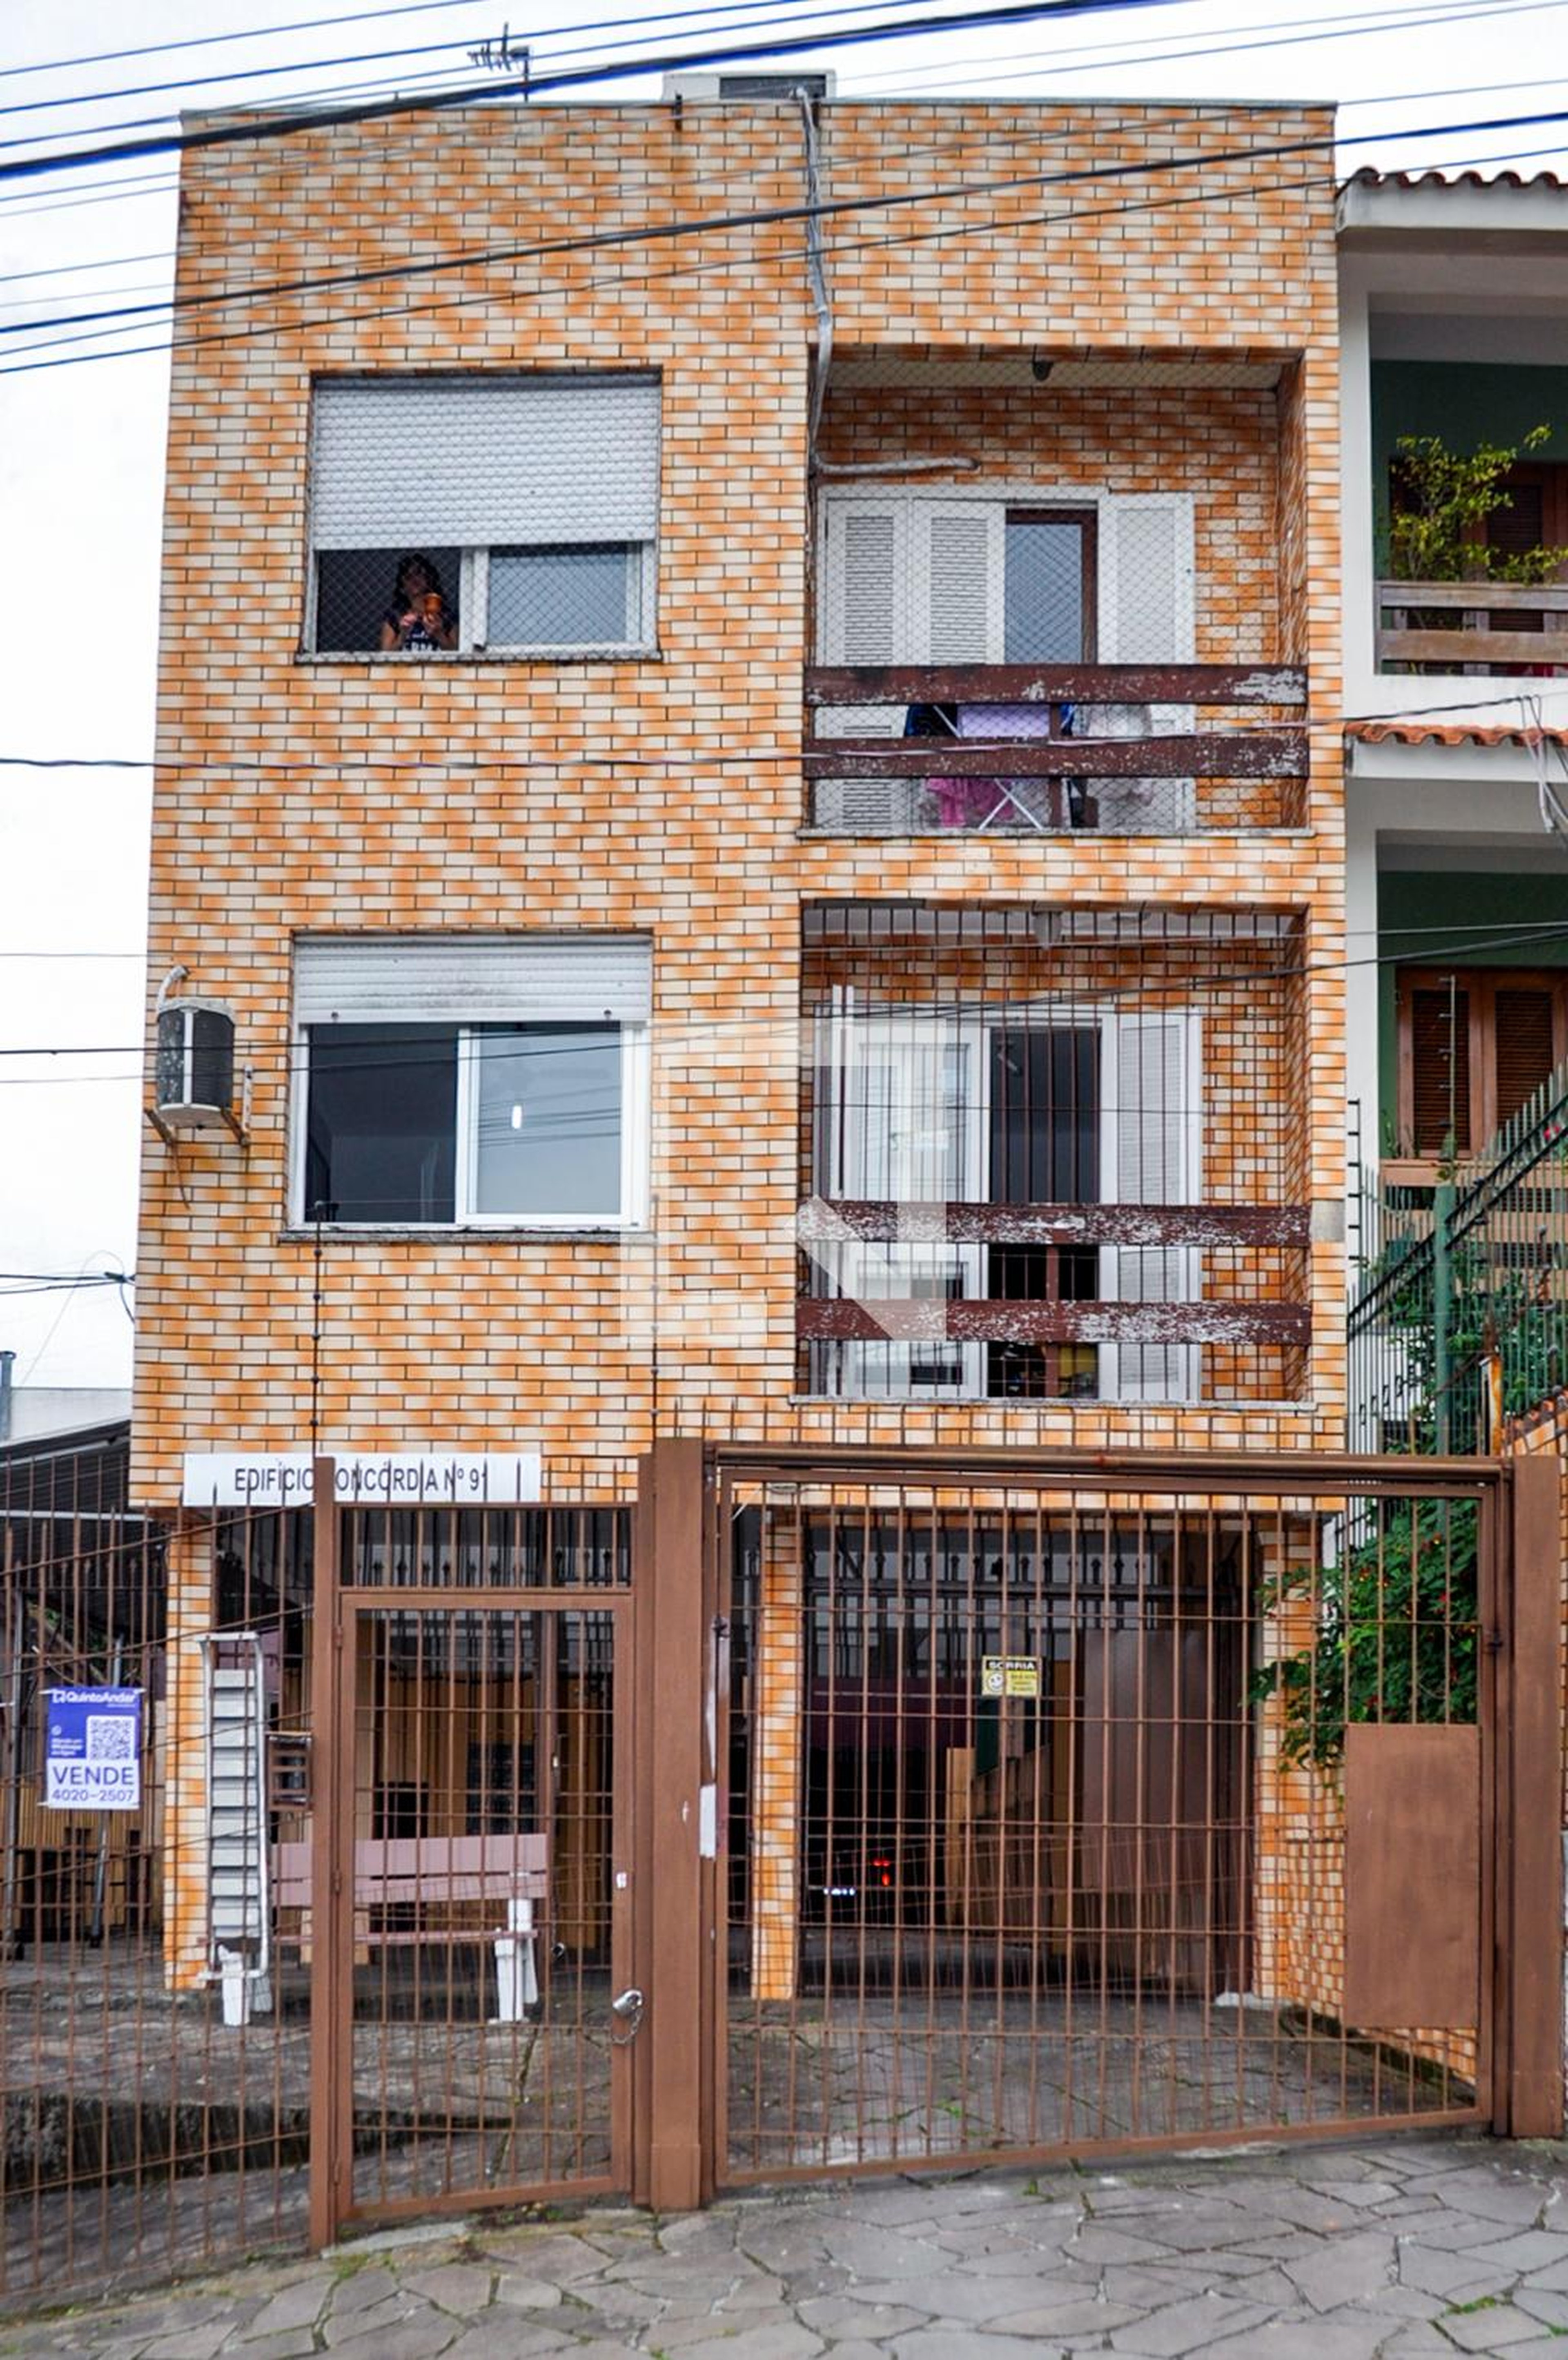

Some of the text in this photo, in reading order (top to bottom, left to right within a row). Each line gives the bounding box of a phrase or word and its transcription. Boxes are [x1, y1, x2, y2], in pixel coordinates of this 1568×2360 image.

[334, 1461, 439, 1491] ONCÓRDA
[53, 1766, 134, 1785] VENDE
[51, 1789, 134, 1802] 4020-2507
